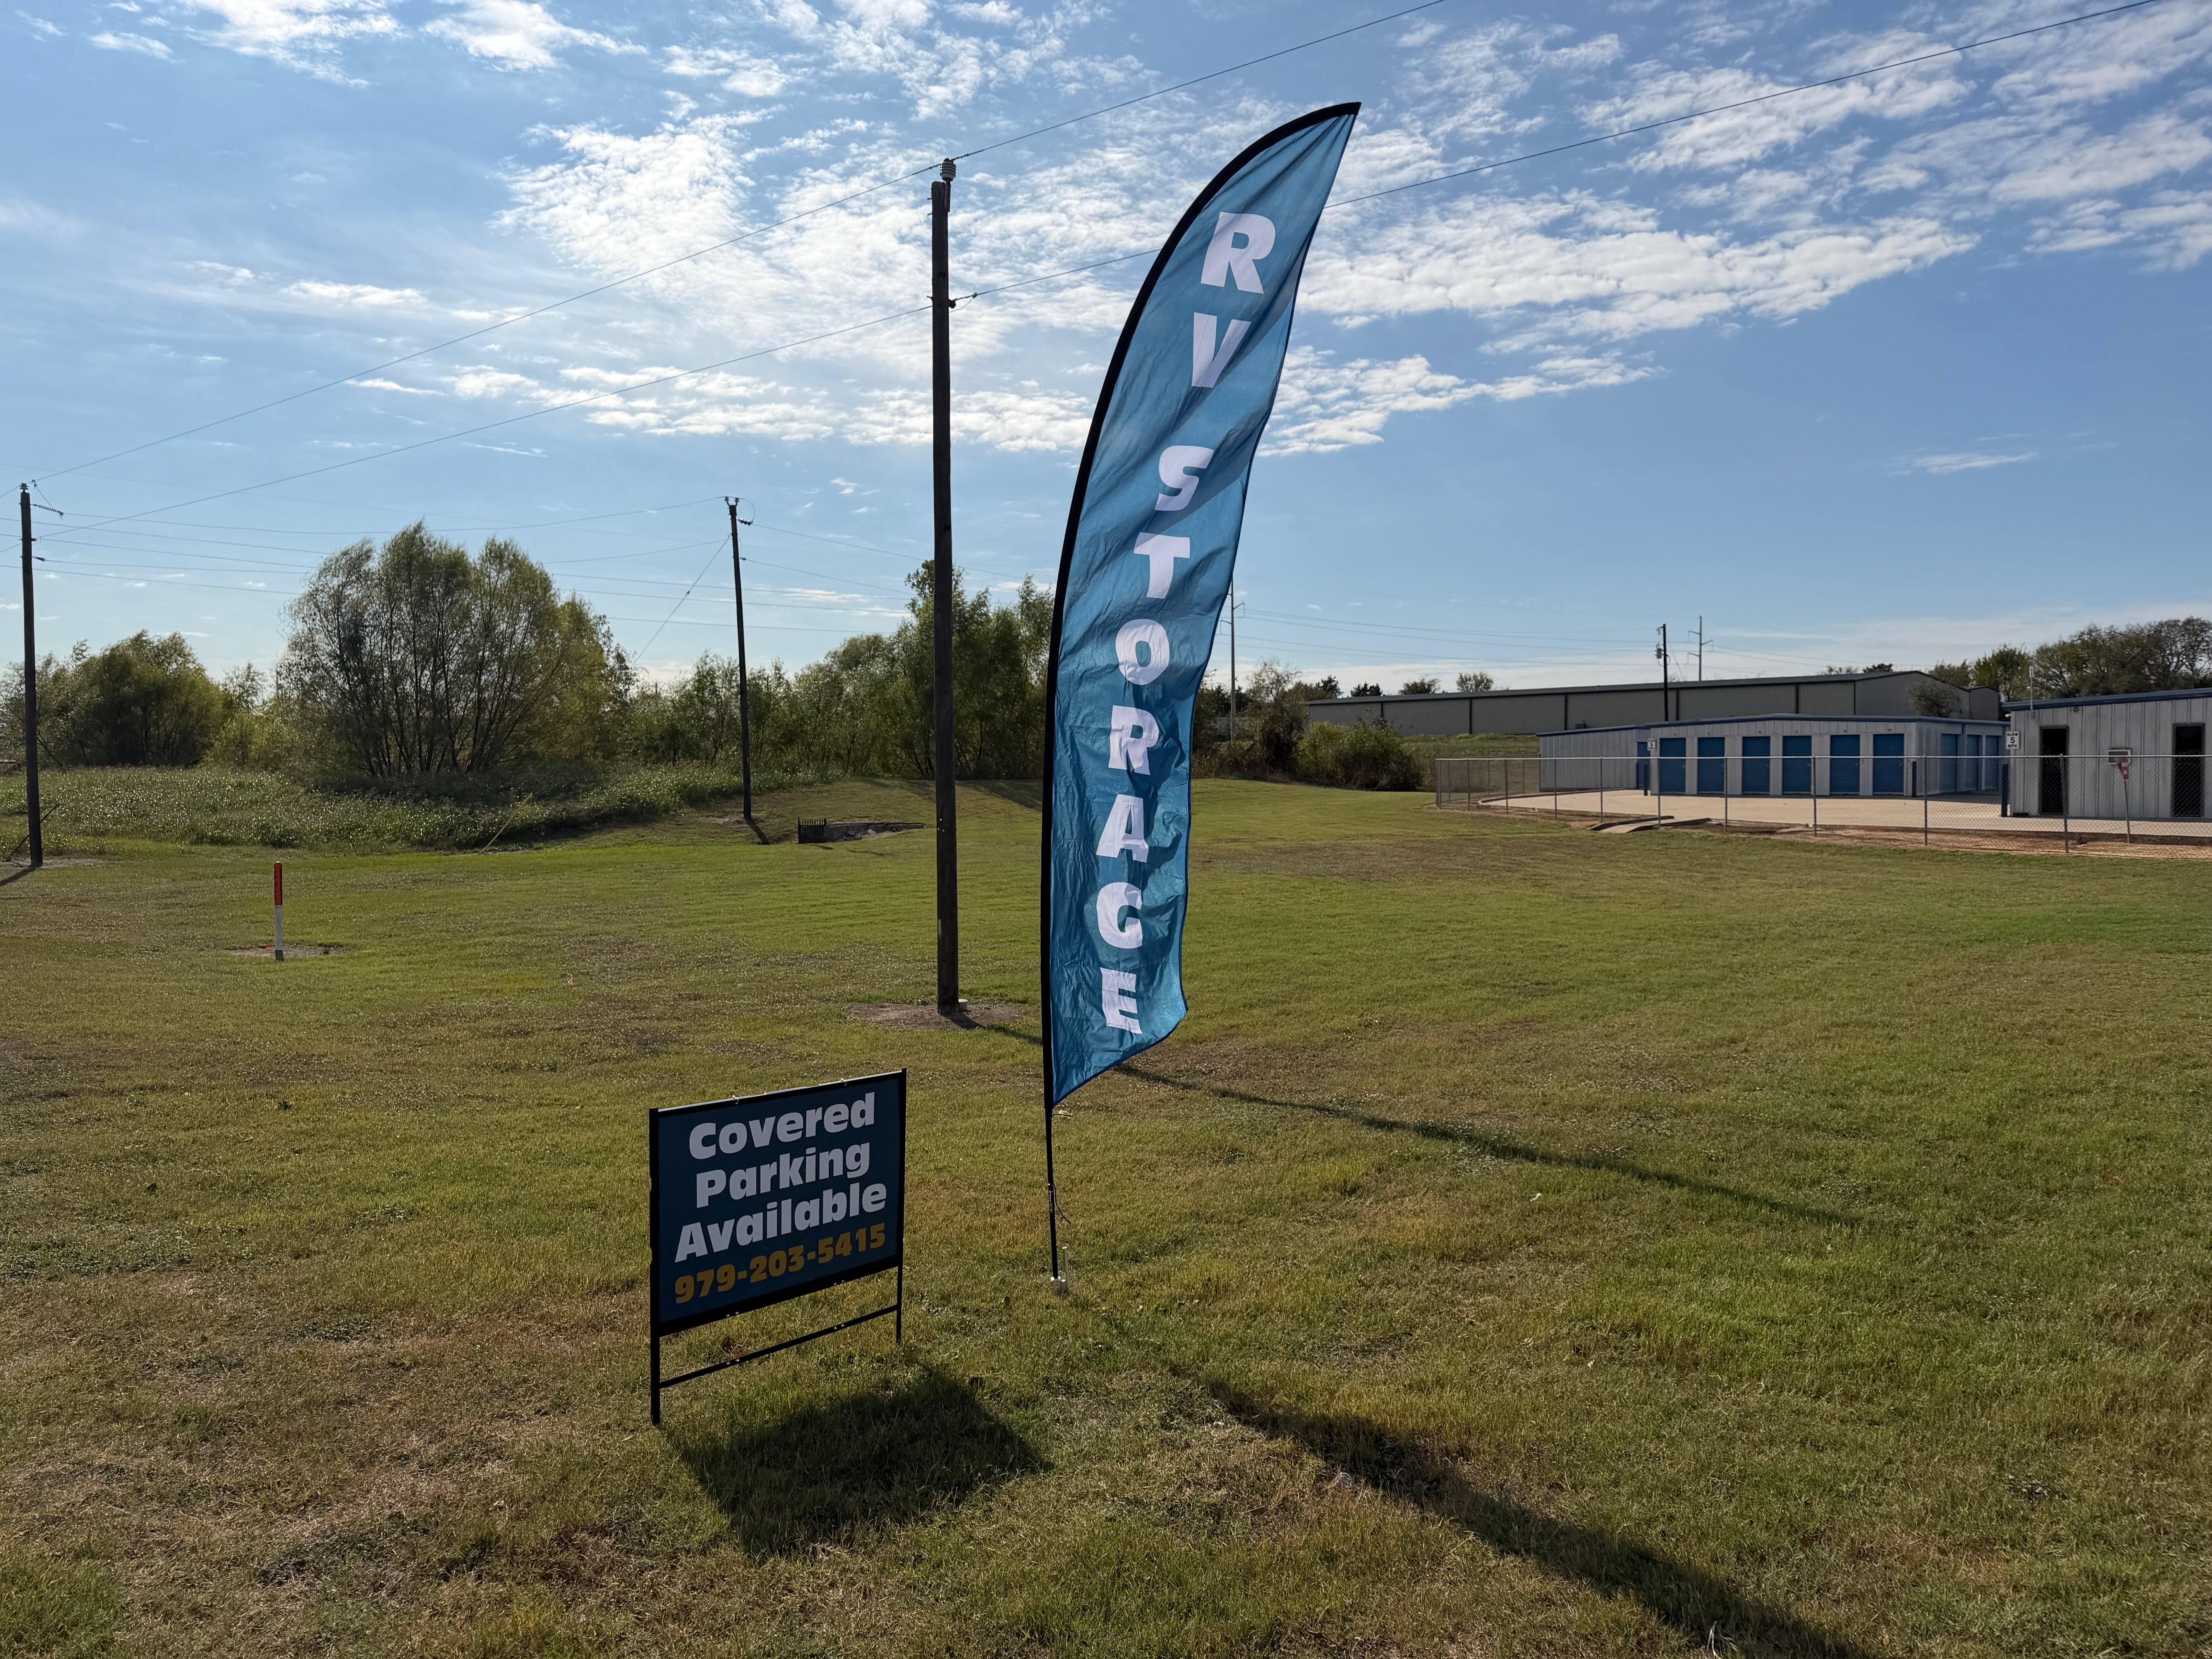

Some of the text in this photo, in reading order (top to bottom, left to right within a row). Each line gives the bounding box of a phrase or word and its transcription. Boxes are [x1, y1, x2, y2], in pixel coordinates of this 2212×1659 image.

[1095, 211, 1276, 1035] RV STORAGE
[689, 1091, 875, 1160] Covered
[696, 1142, 871, 1209] Parking
[674, 1181, 887, 1263] Available
[675, 1223, 886, 1304] 979-203-5415
